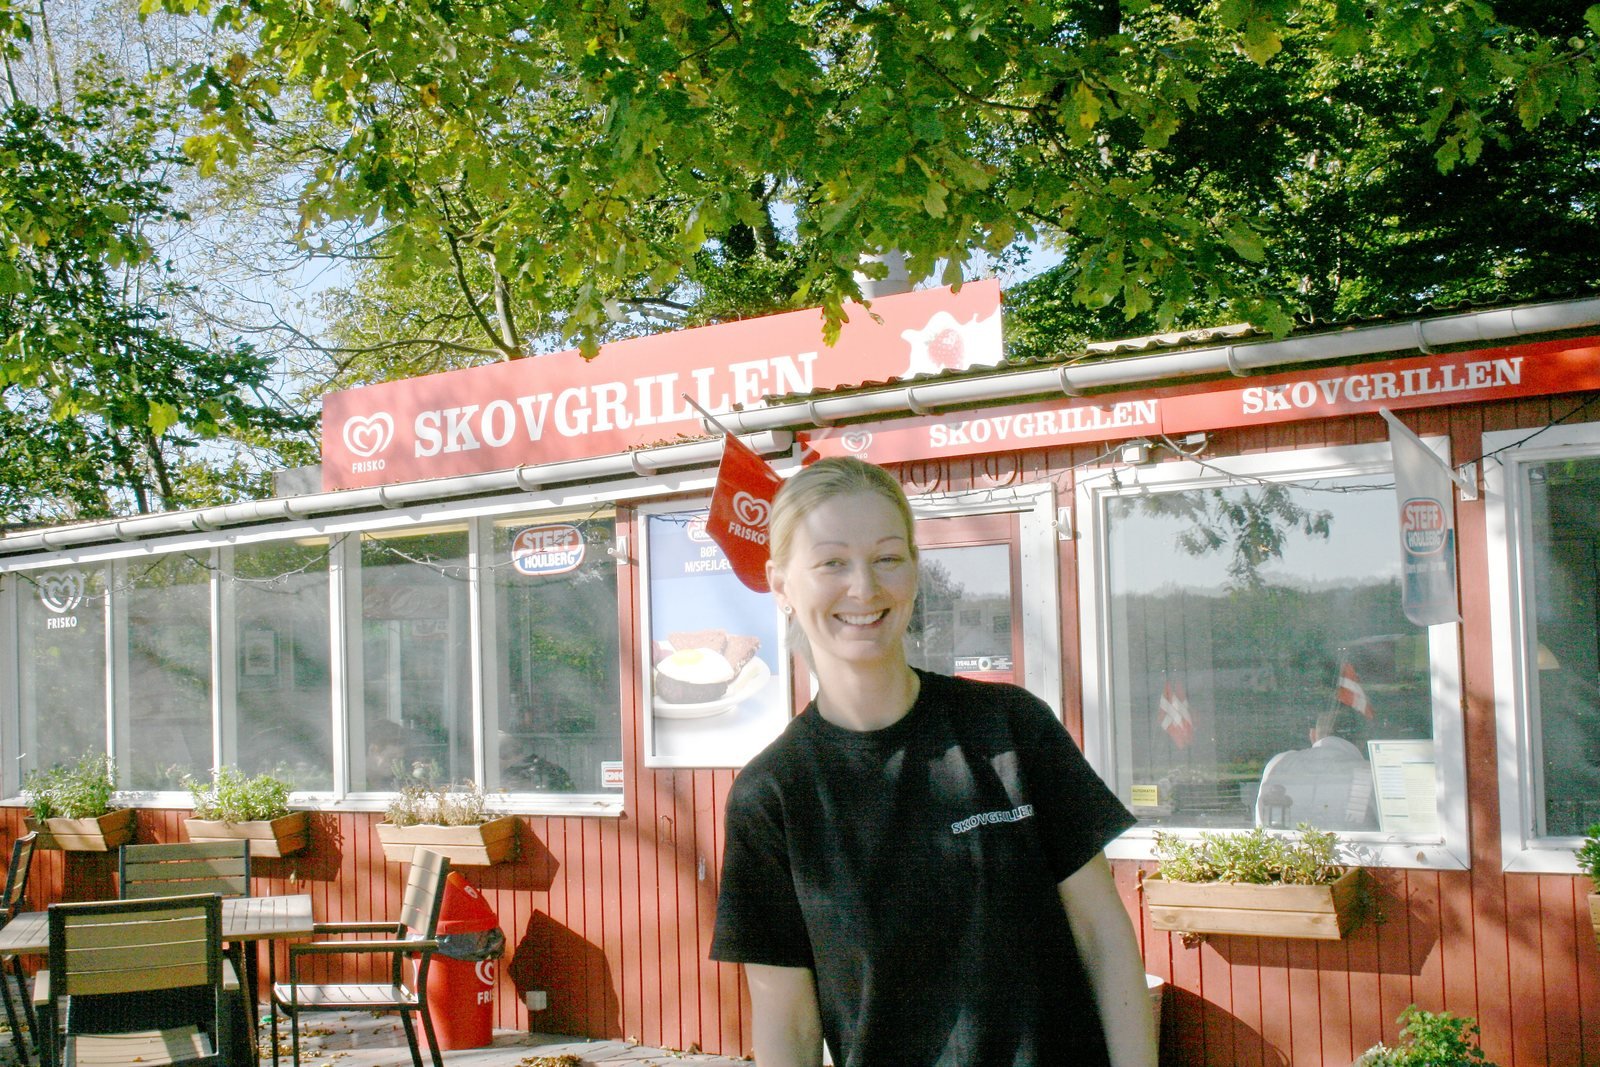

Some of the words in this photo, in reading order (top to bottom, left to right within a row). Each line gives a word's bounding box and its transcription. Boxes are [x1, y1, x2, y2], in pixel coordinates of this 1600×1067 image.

[1241, 357, 1523, 415] SKOVGRILLEN
[414, 352, 818, 458] SKOVGRILLEN
[929, 399, 1158, 448] SKOVGRILLEN
[352, 458, 386, 474] FRISKO
[1406, 505, 1439, 530] STEFF
[522, 529, 573, 552] STEFF
[727, 522, 766, 545] FRISKO
[524, 552, 575, 569] HOULBERG
[700, 546, 718, 558] BØF
[47, 615, 78, 630] FRISKO
[477, 989, 494, 1006] FRI
